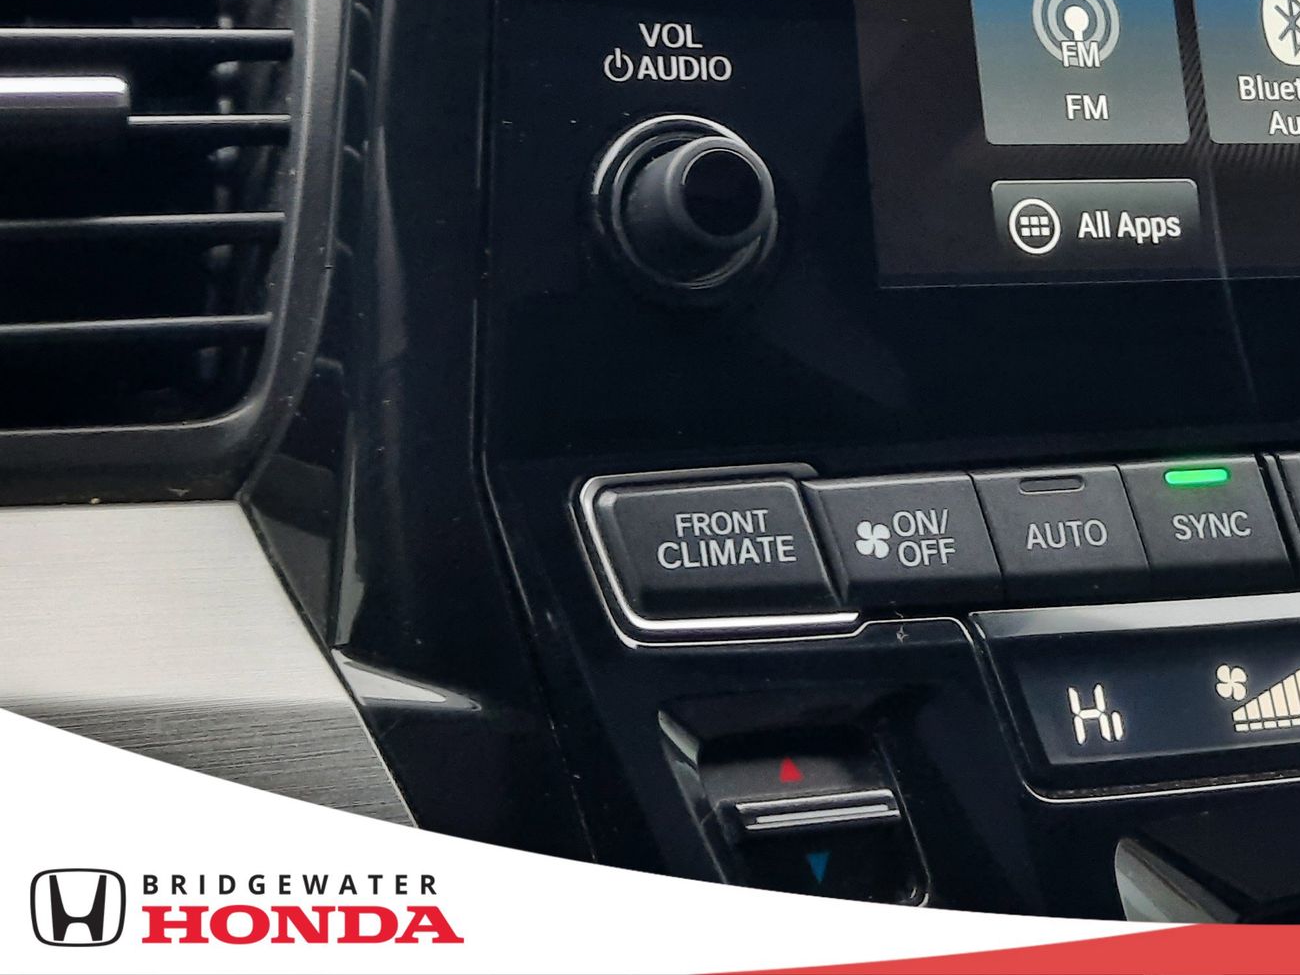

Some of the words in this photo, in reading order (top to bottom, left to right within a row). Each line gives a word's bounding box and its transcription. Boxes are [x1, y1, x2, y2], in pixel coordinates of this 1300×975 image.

[638, 23, 703, 48] VOL
[637, 55, 732, 81] AUDIO
[1060, 39, 1102, 68] FM
[1066, 94, 1109, 120] FM
[1078, 210, 1111, 238] All
[1117, 211, 1182, 244] Apps
[674, 509, 769, 537] FRONT
[892, 508, 948, 537] ON/
[1026, 519, 1108, 550] AUTO
[1172, 511, 1251, 540] SYNC
[657, 537, 797, 569] CLIMATE
[898, 538, 956, 567] OFF
